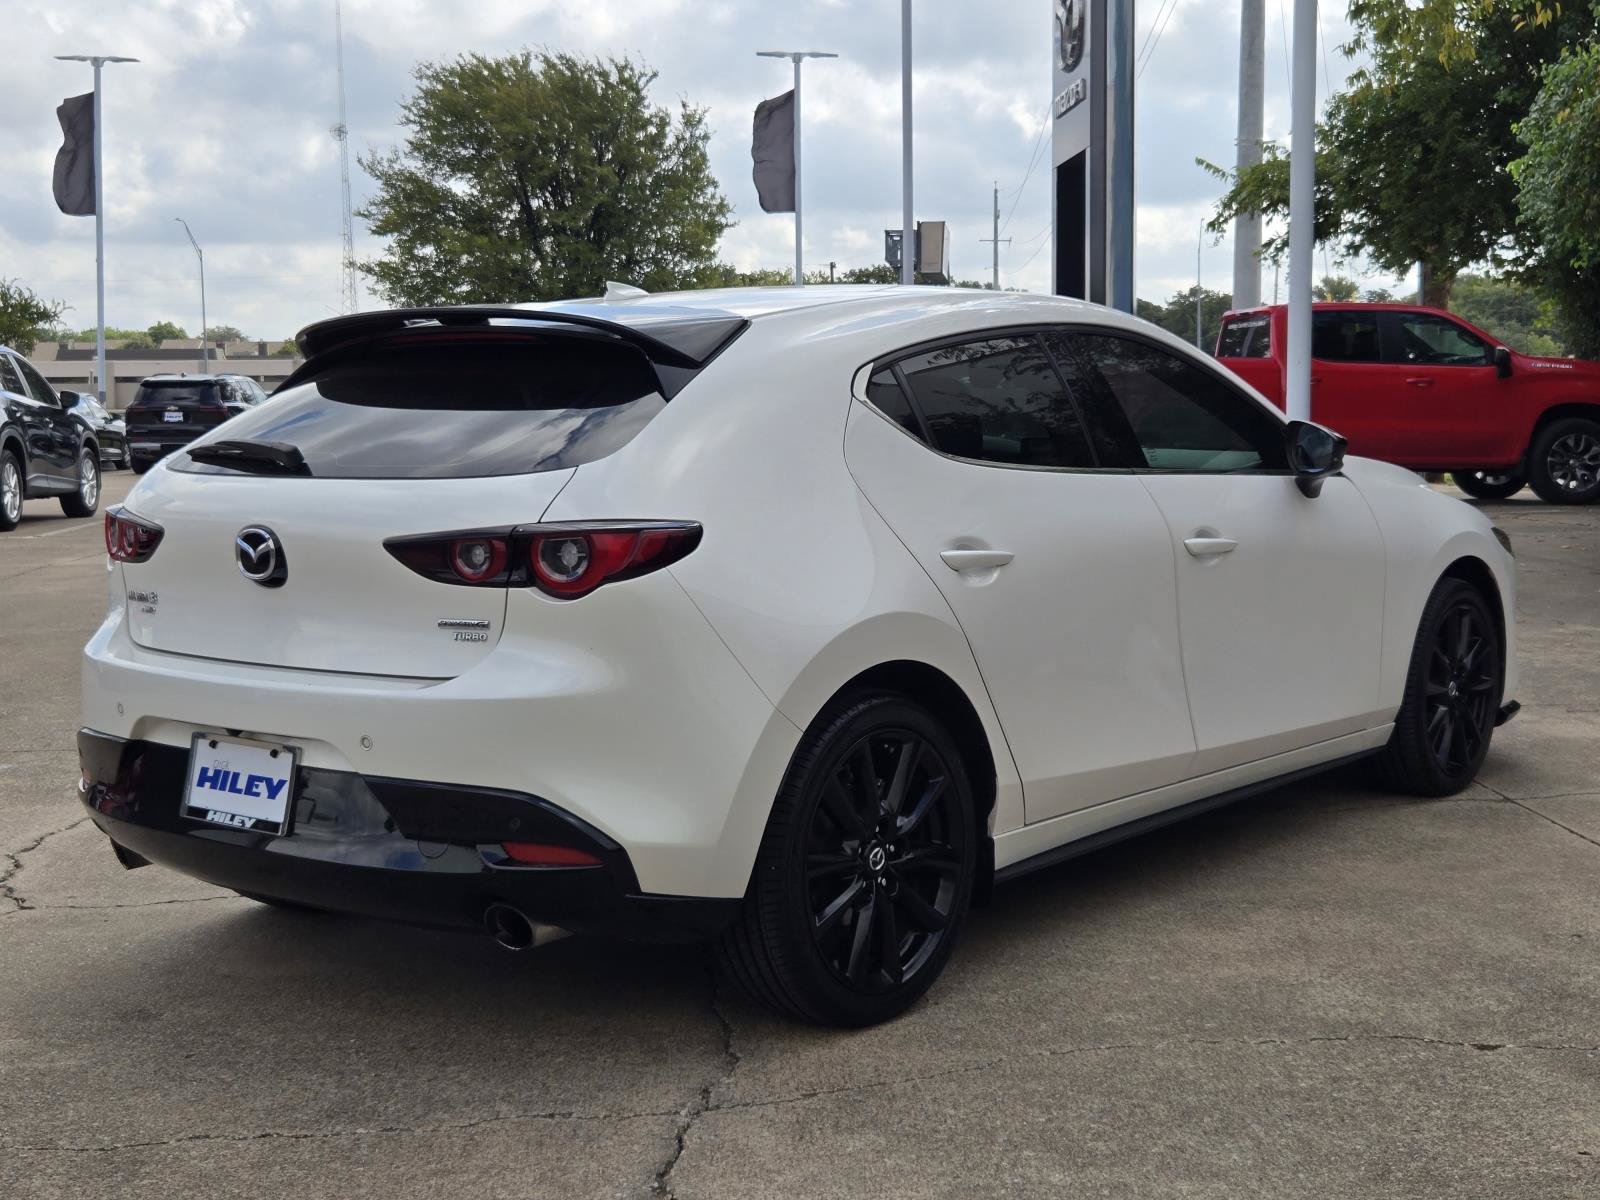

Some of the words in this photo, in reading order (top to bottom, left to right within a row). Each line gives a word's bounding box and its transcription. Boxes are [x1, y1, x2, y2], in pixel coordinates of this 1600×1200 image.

[452, 631, 488, 642] TURBO
[196, 766, 289, 801] HILEY
[206, 810, 257, 829] HILEY
